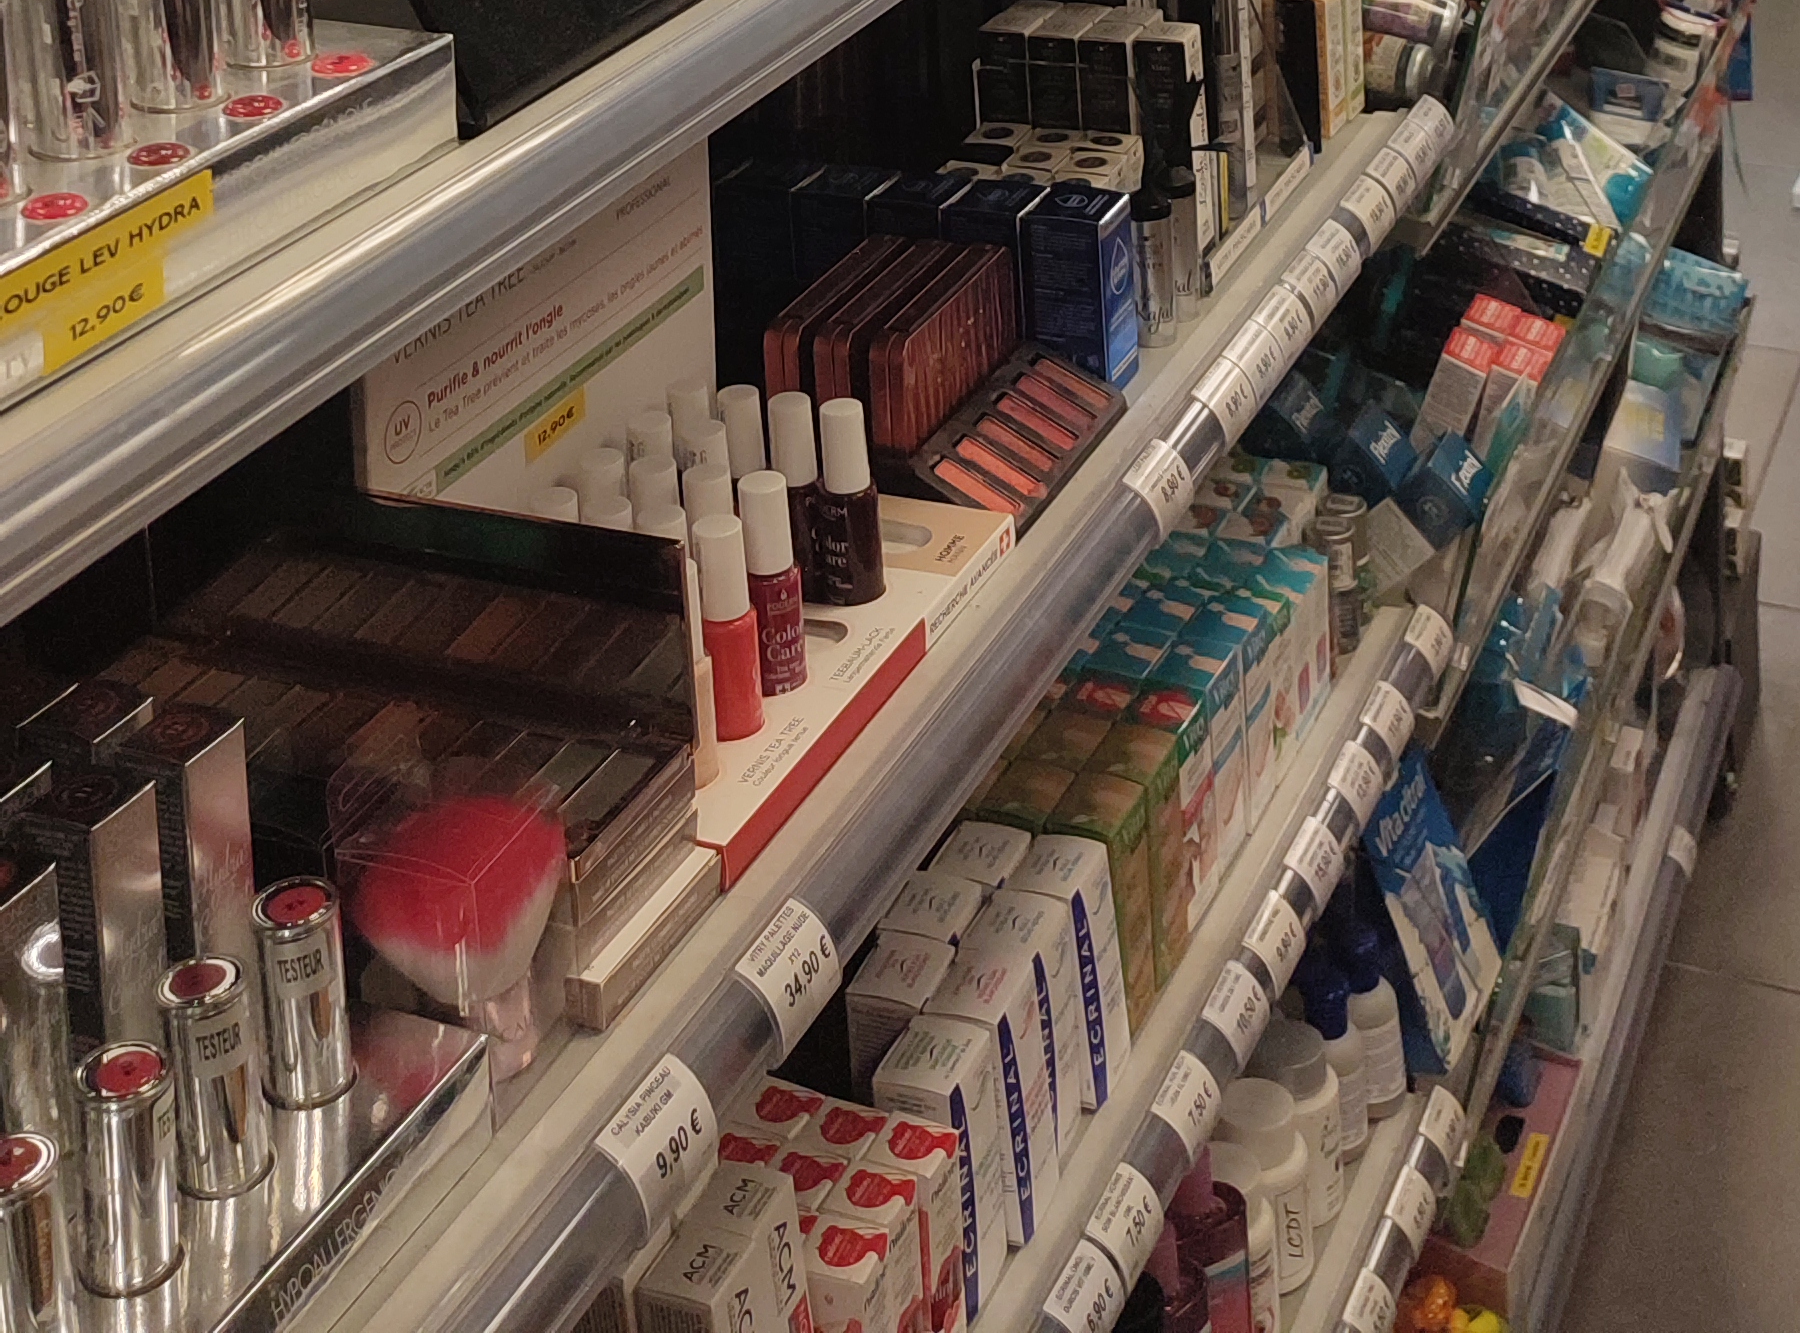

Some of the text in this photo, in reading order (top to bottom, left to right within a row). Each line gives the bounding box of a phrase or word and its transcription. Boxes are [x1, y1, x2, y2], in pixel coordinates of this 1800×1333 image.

[0, 195, 201, 322] OUGE LEV HYDRA
[69, 282, 145, 342] 12,90€
[427, 371, 469, 409] Purifie
[471, 360, 480, 379] &
[483, 331, 524, 370] nourrit
[526, 303, 563, 341] l'ongle
[394, 413, 411, 436] UV
[934, 533, 965, 563] HOMME
[737, 716, 805, 784] VERNIS TEA TREE
[277, 947, 325, 977] TESTEUR
[749, 904, 795, 962] VITRY PALETTES
[756, 910, 811, 978] MAQUILLAGE NUDE
[784, 933, 831, 1008] 34,90 €
[1075, 916, 1105, 1067] ECRINAL
[195, 1020, 242, 1064] TESTEUR
[610, 1065, 671, 1136] CALYSIA PINCEAU
[634, 1088, 675, 1137] KABUKI GM
[1001, 1044, 1031, 1202] ECRINAL
[656, 1107, 703, 1180] 9,90 €
[722, 1178, 756, 1216] ACM
[957, 1115, 978, 1278] ECRINAL
[683, 1243, 719, 1283] ACM
[774, 1220, 797, 1308] ACM
